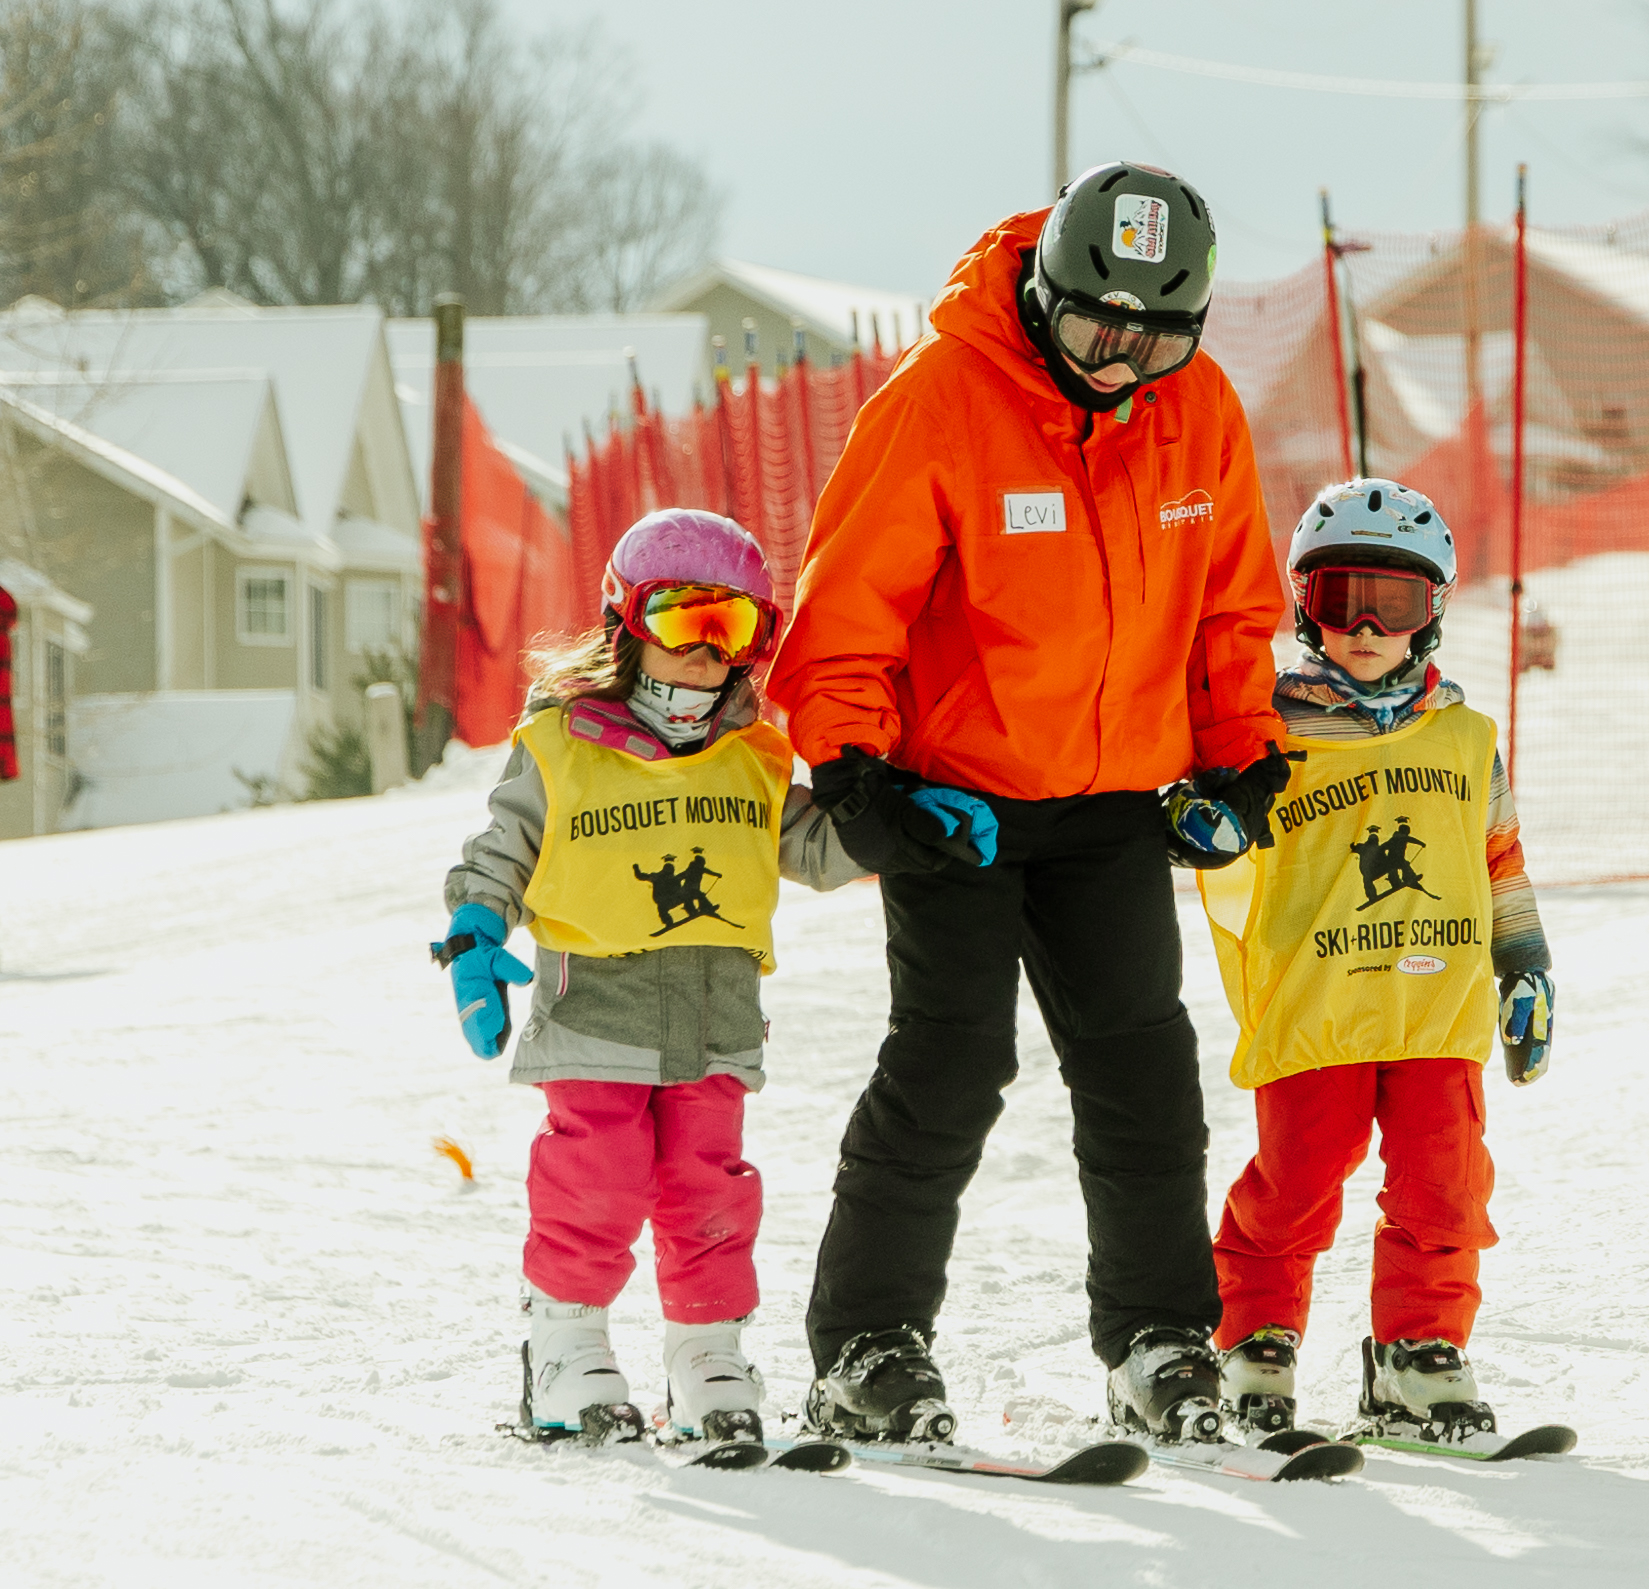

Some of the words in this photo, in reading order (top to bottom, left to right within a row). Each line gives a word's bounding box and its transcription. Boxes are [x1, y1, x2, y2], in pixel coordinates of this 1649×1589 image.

[1008, 498, 1057, 530] Levi
[1159, 502, 1214, 523] BOUSQUET
[1276, 770, 1378, 833] BOUSQUET
[570, 797, 679, 842] BOUSQUET
[1410, 917, 1482, 946] SCHOOL
